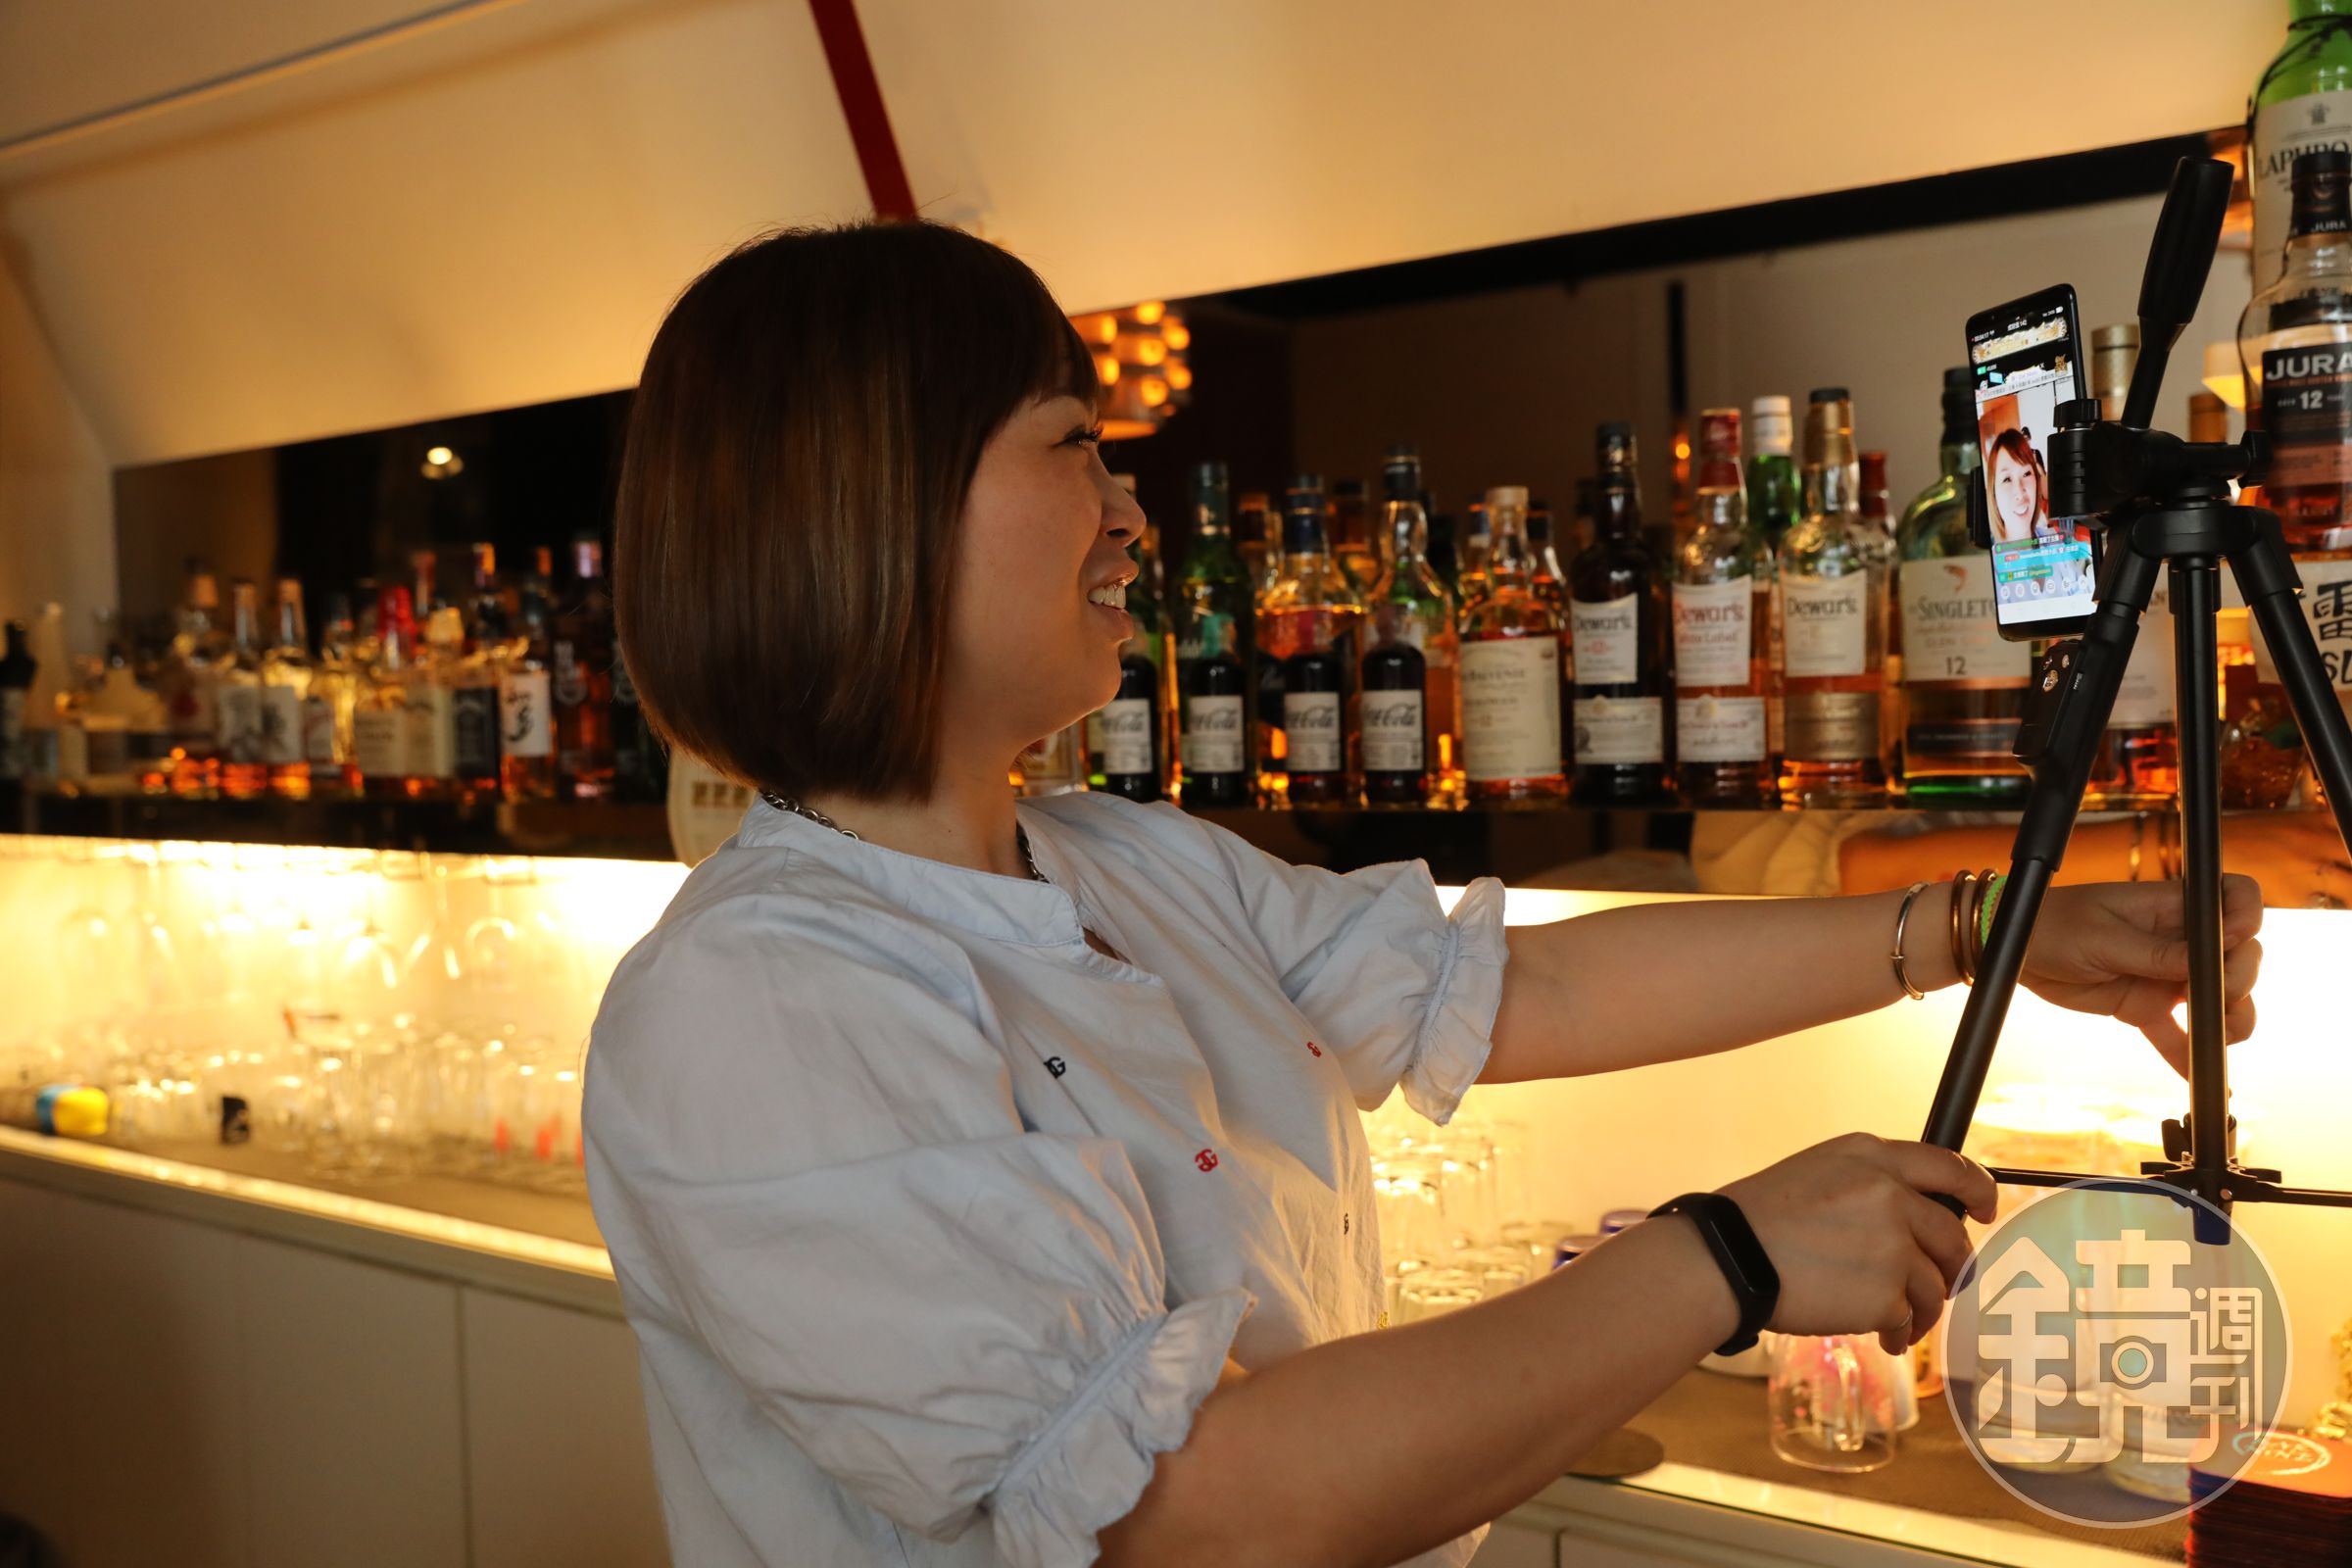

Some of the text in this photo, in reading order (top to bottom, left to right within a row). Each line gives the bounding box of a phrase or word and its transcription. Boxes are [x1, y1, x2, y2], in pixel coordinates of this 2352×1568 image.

[2266, 352, 2352, 381] JURA
[2300, 390, 2324, 410] 12
[1945, 655, 1967, 676] 12
